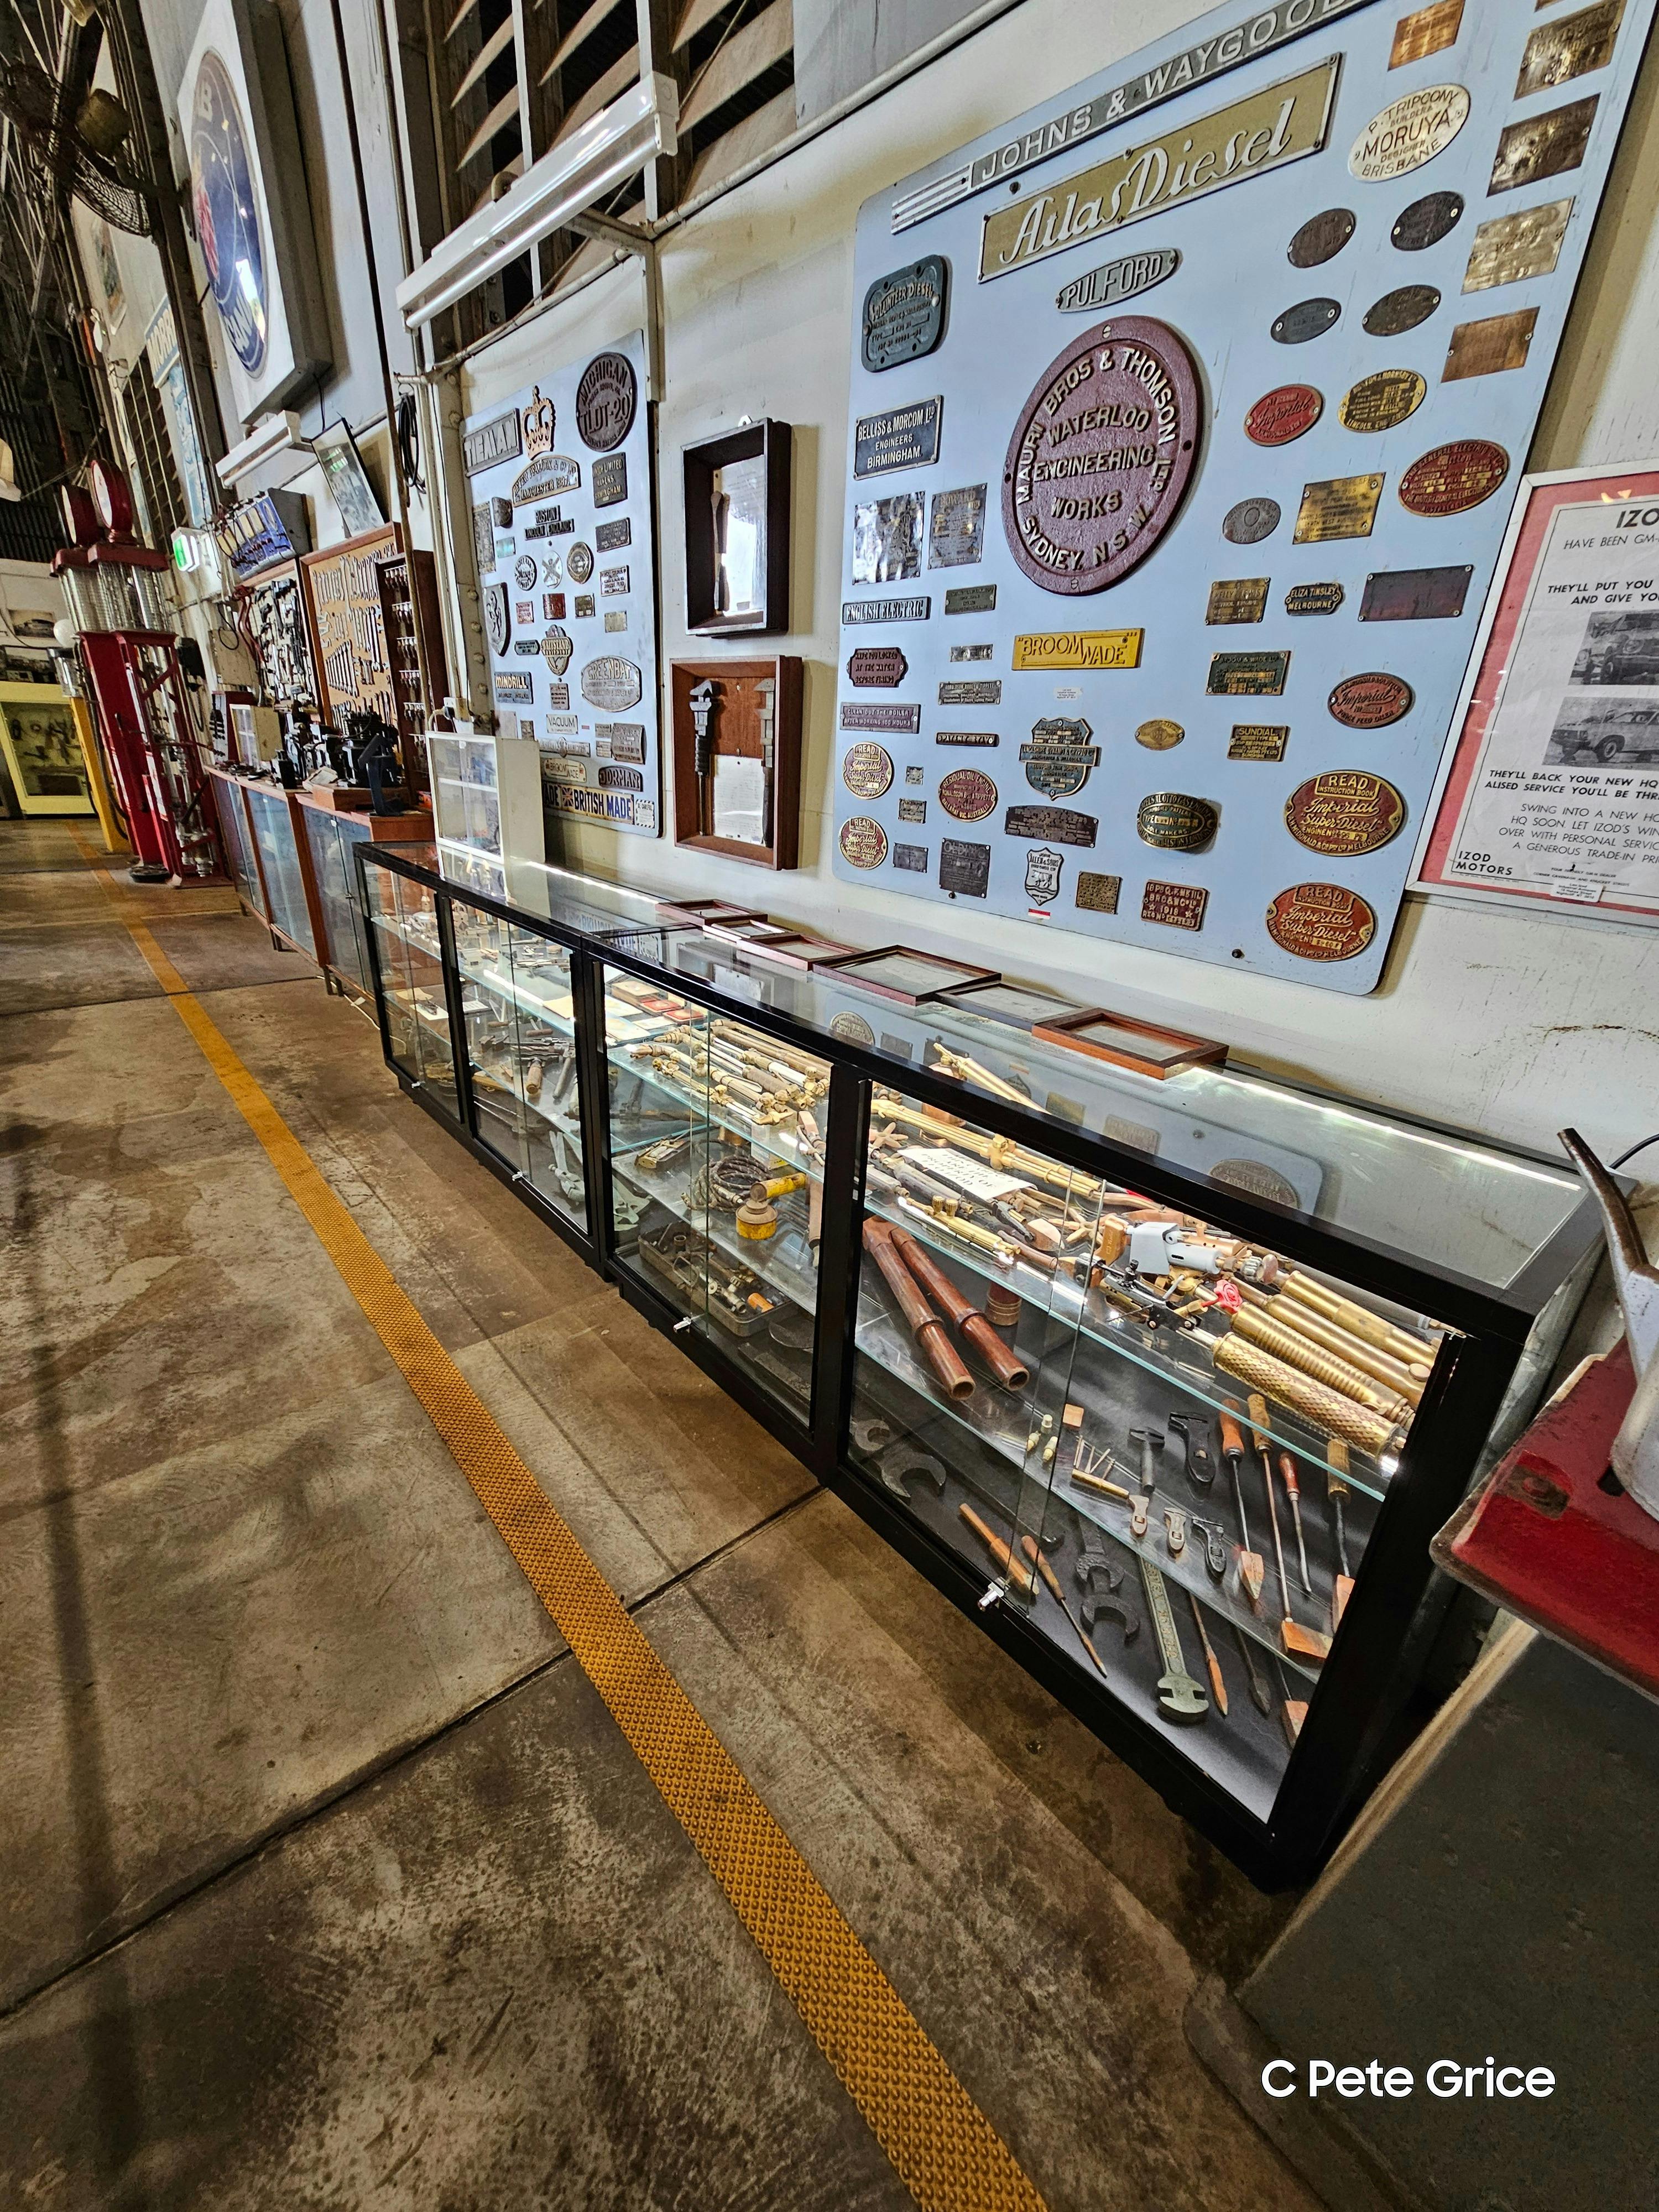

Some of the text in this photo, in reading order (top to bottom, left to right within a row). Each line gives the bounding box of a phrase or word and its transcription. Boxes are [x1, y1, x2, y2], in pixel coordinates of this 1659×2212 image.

[982, 105, 1091, 181] JOHNS
[1107, 89, 1127, 120] &
[1145, 0, 1347, 98] WAYGOO
[1384, 89, 1459, 119] TRIPCONY
[1363, 108, 1451, 161] MORUYA
[1123, 97, 1297, 216] Diesel
[1362, 139, 1442, 176] BRISBANE
[1380, 139, 1426, 163] DESIGNER
[1066, 253, 1161, 308] PULFORD
[909, 283, 935, 297] DIESEL
[146, 304, 177, 376] MORRI
[580, 359, 628, 406] MICHIGAN
[1383, 371, 1408, 380] HORNSBY
[581, 394, 630, 435] TLDT-20
[1253, 396, 1310, 430] Imperial
[858, 411, 923, 442] BELLISS & MORCOM
[1018, 348, 1177, 505] MAURI BROS & THOMSON
[1047, 405, 1150, 447] WATERLOO
[875, 434, 913, 451] ENGINEERS
[1034, 445, 1155, 482] ENGINEERING
[1420, 444, 1487, 466] GENERAL ELECTRIC
[604, 459, 623, 473] LIMITED
[521, 480, 554, 500] MANCHESTER
[1052, 490, 1121, 519] WORKS
[536, 507, 557, 524] RUSTON
[1616, 508, 1659, 529] IZO
[1564, 533, 1659, 550] HAVE BEEN GM-
[1291, 586, 1337, 598] ELIZA TINSLEY
[1548, 580, 1654, 593] THEY'LL PUT YOU
[1288, 601, 1332, 610] MELBOURNE
[1571, 595, 1598, 604] AND
[1605, 593, 1632, 603] GIVE
[846, 599, 924, 622] ENGLISH ELECTRIC
[855, 651, 898, 660] HAVE YOU LOOKED
[587, 658, 632, 680] GREENBAT
[495, 676, 528, 689] MINDRILL
[1337, 689, 1396, 709] Imperial
[549, 716, 575, 727] VACUUM
[858, 744, 876, 755] READ
[550, 763, 567, 773] BROOM
[849, 759, 883, 773] Imperial
[601, 769, 640, 789] DORMAN
[943, 771, 967, 789] RESIDUAL
[976, 775, 993, 794] ENGINE
[1329, 775, 1369, 790] READ
[1489, 770, 1658, 789] THEY'LL BACK YOUR NEW HQ
[1317, 786, 1355, 795] INSTRUCTION
[1485, 781, 1630, 798] ALISED SERVICE YOU'LL BE
[544, 783, 632, 820] ADE BRITISH MADE
[942, 797, 990, 818] BALLARAT AUSTRALIA
[1162, 794, 1189, 805] OTTO GAS
[1304, 797, 1380, 817] Imperial
[1143, 814, 1154, 823] TYPE
[1521, 804, 1557, 814] SWING
[1562, 807, 1589, 817] INTO
[1609, 811, 1638, 820] NEW
[854, 818, 872, 828] READ
[1147, 825, 1158, 833] SOLE
[1302, 826, 1326, 836] ENGINE
[1511, 816, 1527, 825] HQ
[1572, 821, 1589, 830] LET
[1594, 823, 1630, 834] IZOD'S
[846, 832, 878, 845] Imperial
[1348, 827, 1390, 851] MELBOURNE
[1499, 827, 1659, 851] OVER WITH PERSONAL SERVIC
[1030, 853, 1043, 864] ALLEN
[1047, 858, 1058, 867] SONS
[1458, 851, 1491, 862] IZOD
[1527, 842, 1581, 855] GENEROUS
[1588, 849, 1635, 861] TRADE-IN
[1642, 854, 1659, 864] PRI
[1455, 862, 1513, 875] MOTORS
[1296, 896, 1331, 907] INSTRUCTION
[1306, 886, 1344, 902] READ
[1161, 905, 1178, 915] 1918
[1282, 906, 1354, 927] Imperial
[1281, 931, 1304, 942] ENGINE
[1323, 937, 1364, 957] MELBOURNE
